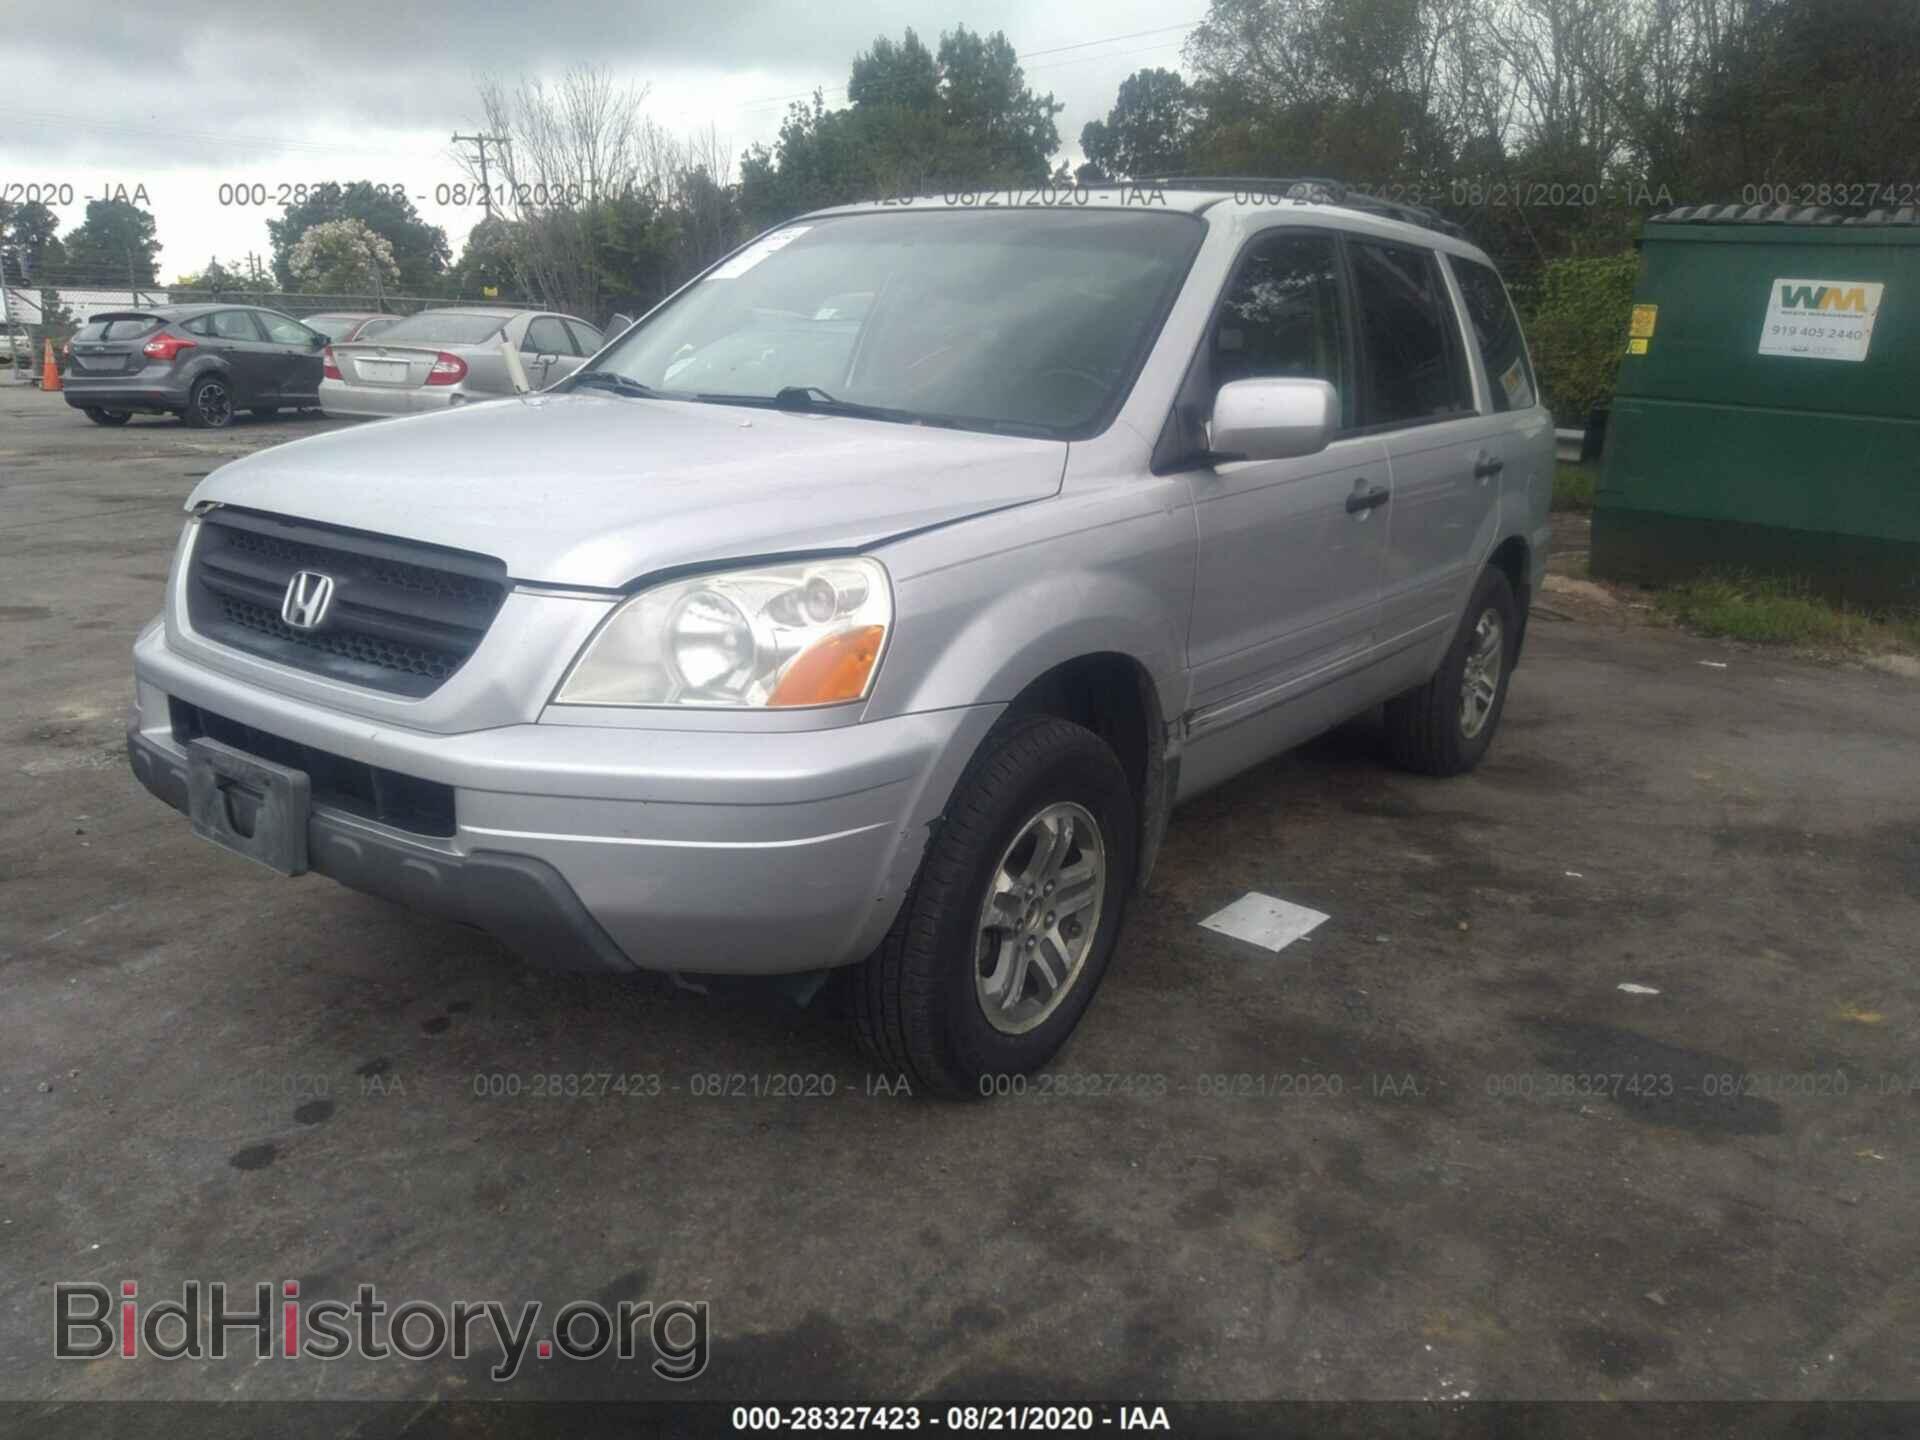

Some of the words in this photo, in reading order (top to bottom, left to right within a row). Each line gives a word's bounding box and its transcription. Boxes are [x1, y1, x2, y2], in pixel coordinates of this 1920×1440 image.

[1782, 285, 1866, 312] WM
[1771, 324, 1797, 338] 919
[1800, 326, 1824, 339] 405
